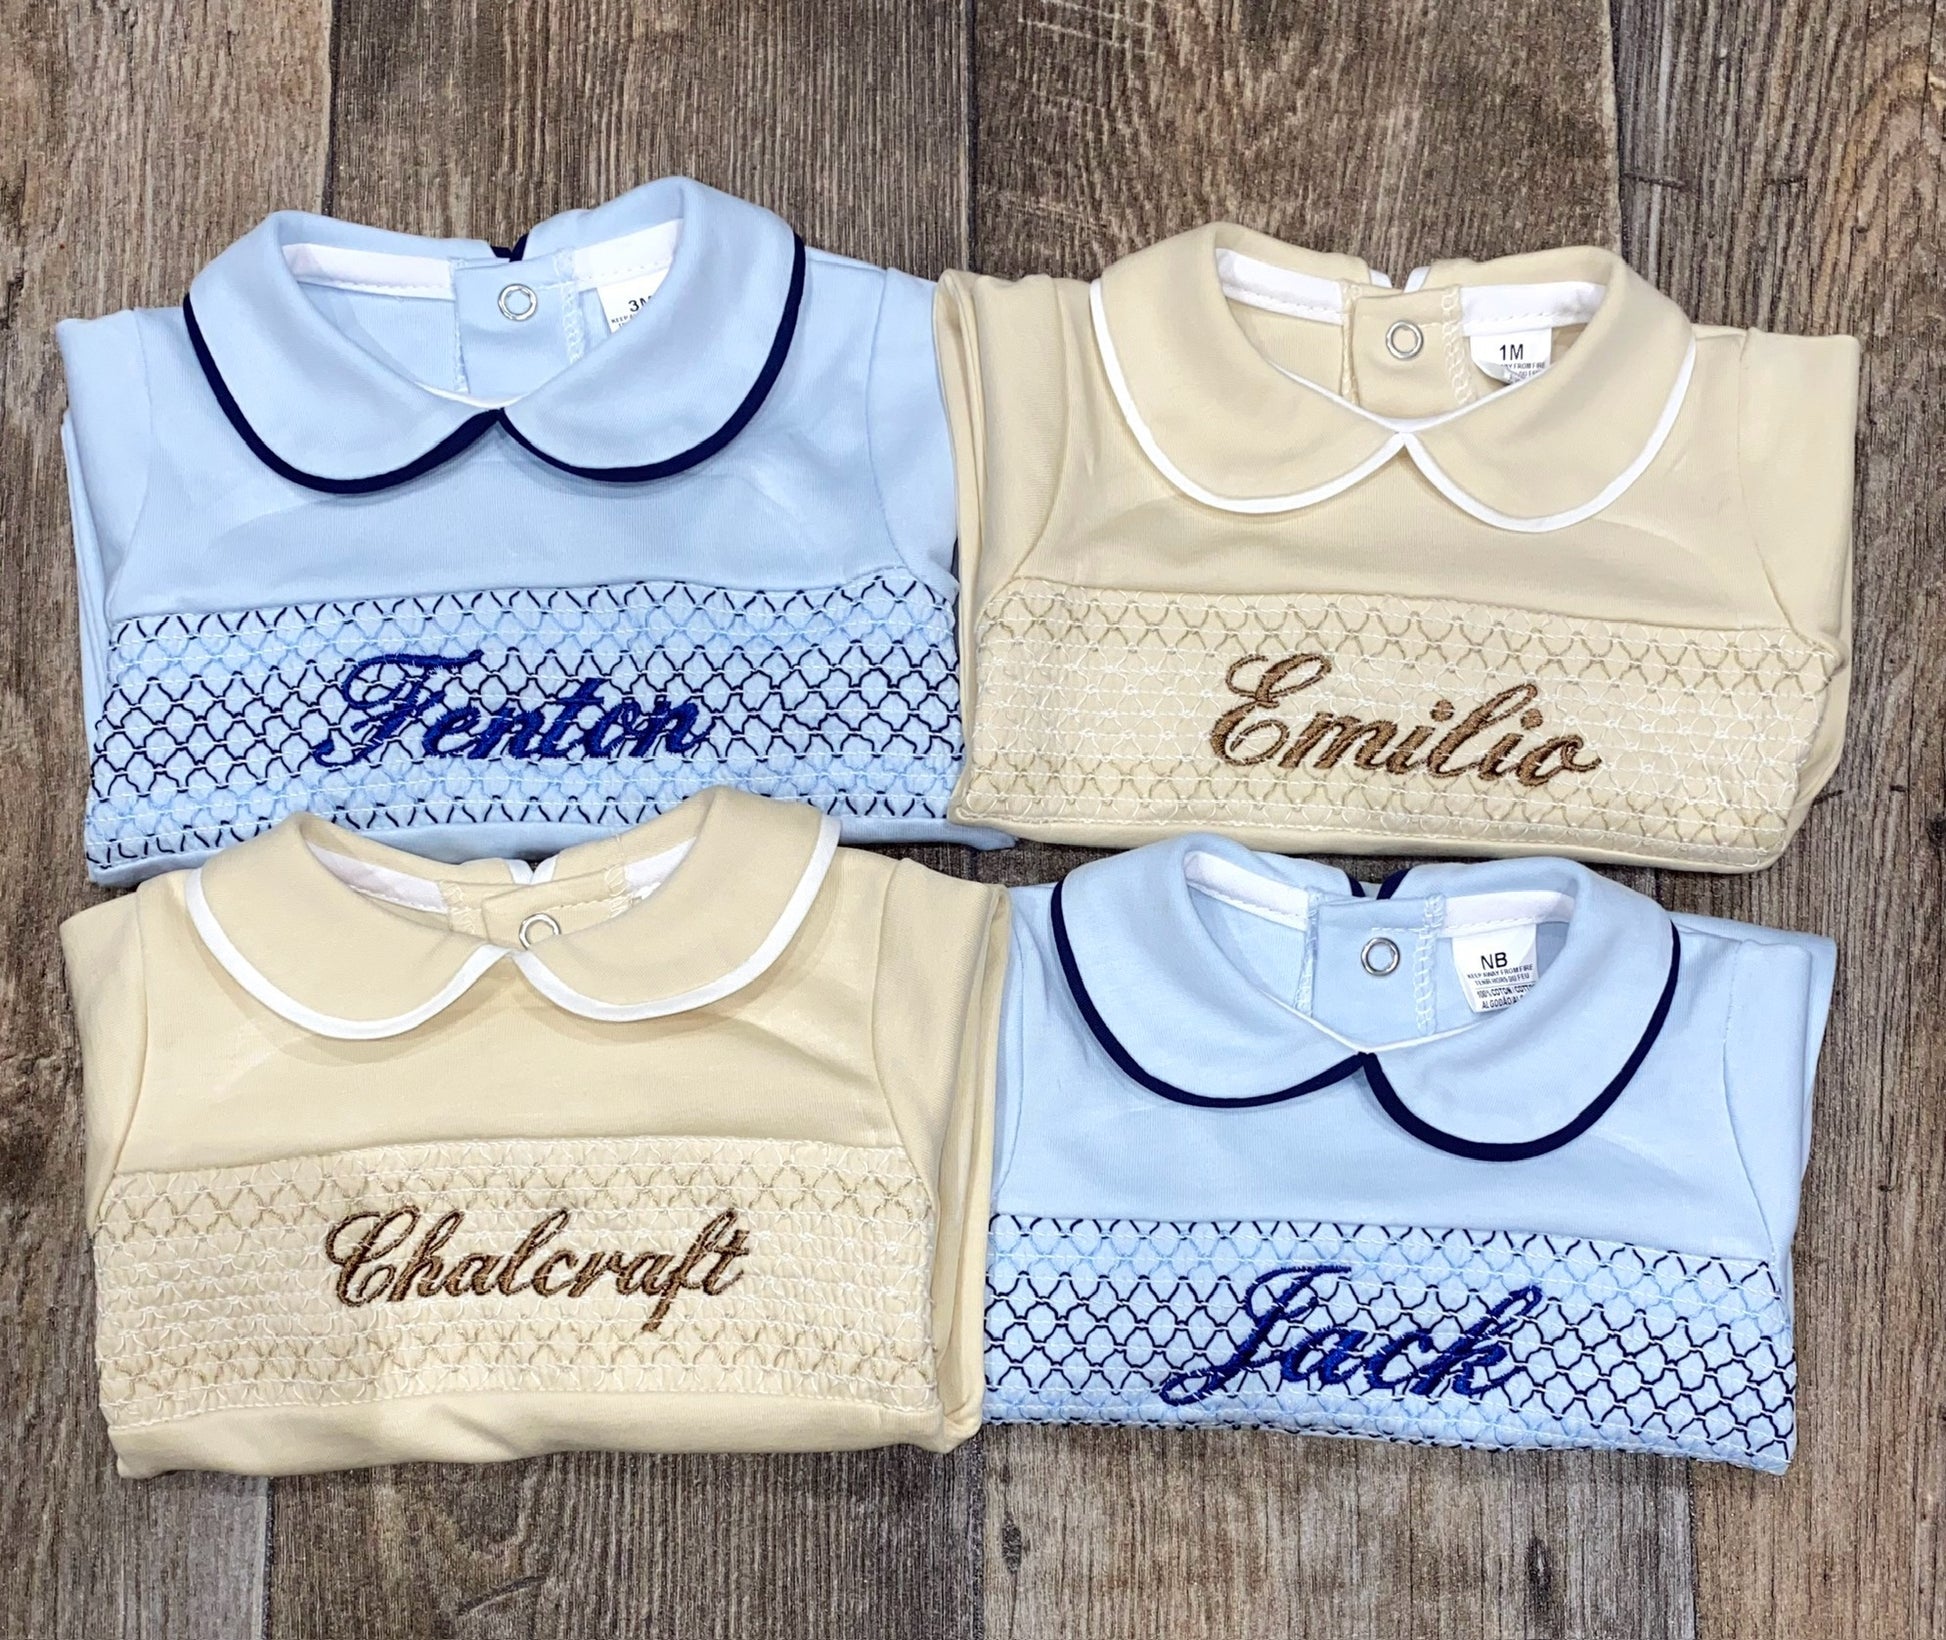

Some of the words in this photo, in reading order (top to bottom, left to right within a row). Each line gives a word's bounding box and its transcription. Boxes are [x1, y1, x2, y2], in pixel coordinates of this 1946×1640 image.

[1499, 343, 1524, 361] 1M
[312, 649, 711, 768] Fenton
[1210, 653, 1601, 787] Emilio
[1481, 952, 1508, 970] NB
[1500, 967, 1519, 976] FROM
[325, 1204, 750, 1333] Chalcraft
[1160, 1265, 1543, 1407] Jack
